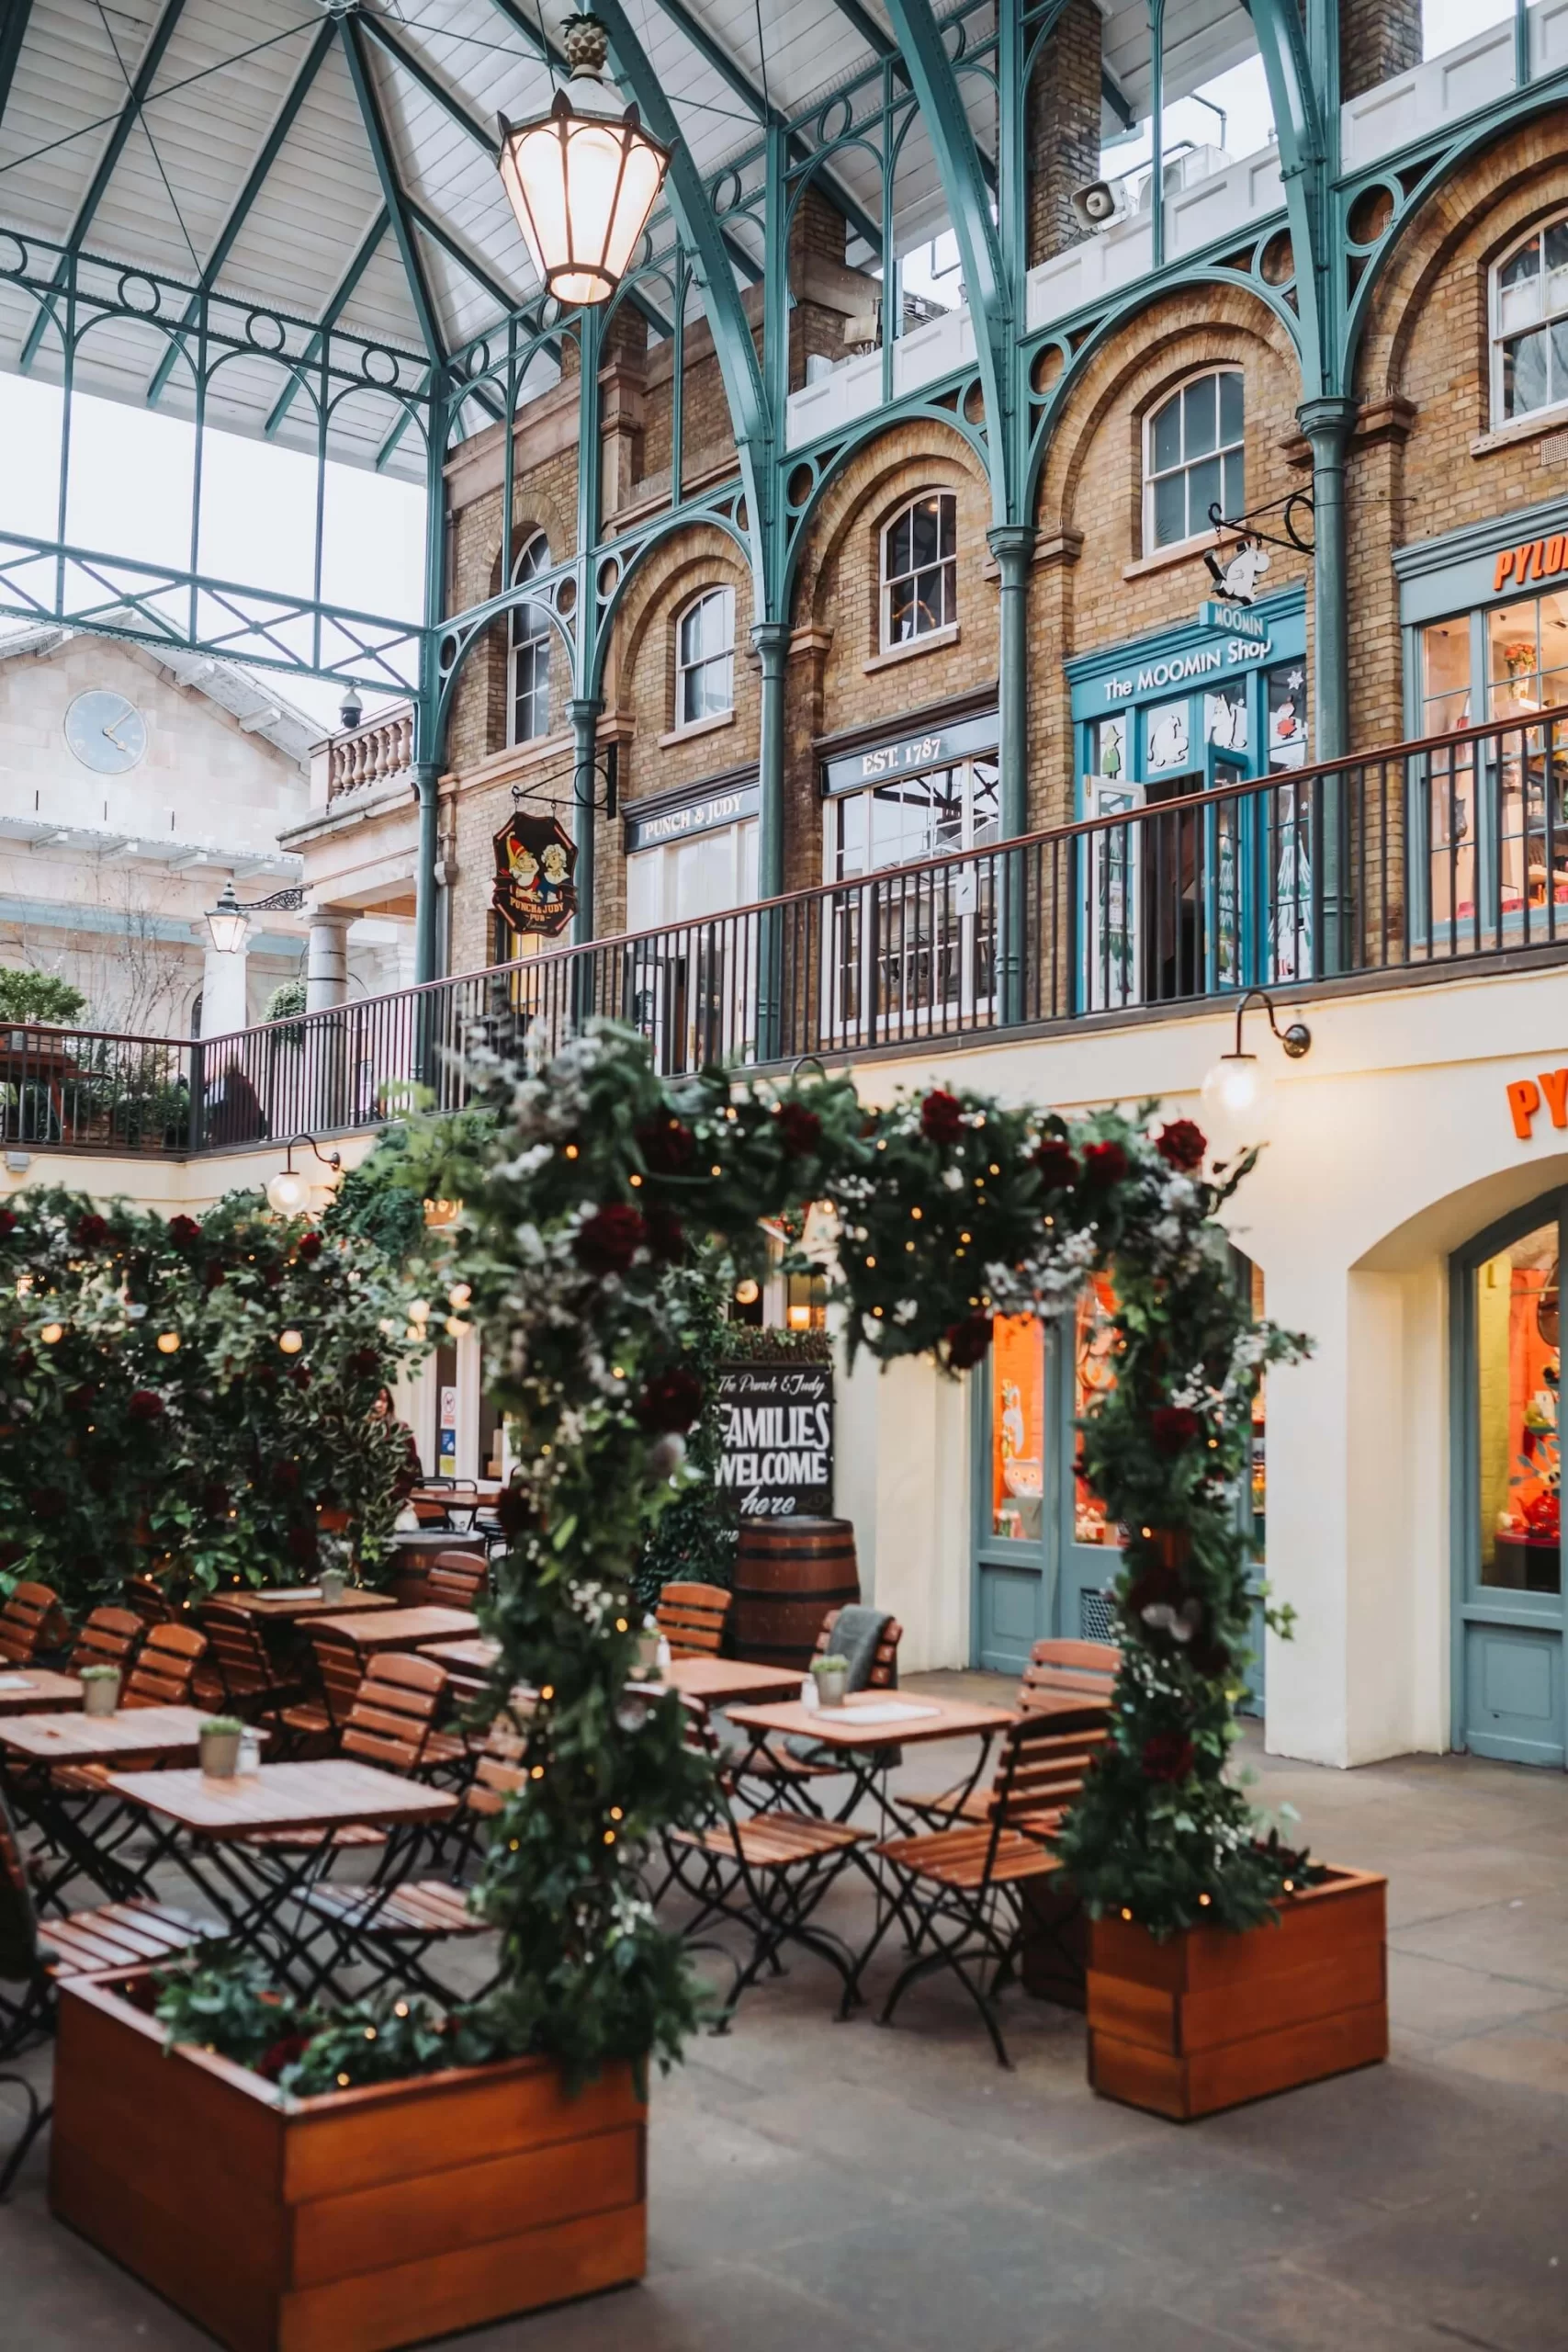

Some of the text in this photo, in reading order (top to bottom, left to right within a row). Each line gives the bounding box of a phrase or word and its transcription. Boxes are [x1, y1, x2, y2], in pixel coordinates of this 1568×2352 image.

[1494, 535, 1568, 592] PYLO
[1214, 605, 1264, 636] MOOMIN
[1104, 639, 1272, 701] The MOOMIN Shop
[863, 738, 941, 776] EST. 1787
[645, 792, 743, 840] PUNCH & JUDY
[530, 913, 546, 922] PUB
[542, 902, 564, 914] JUDY
[718, 1374, 738, 1394] The
[739, 1373, 777, 1394] Punch
[789, 1374, 826, 1400] Judy
[714, 1452, 829, 1487] WELCOME
[740, 1486, 796, 1515] here
